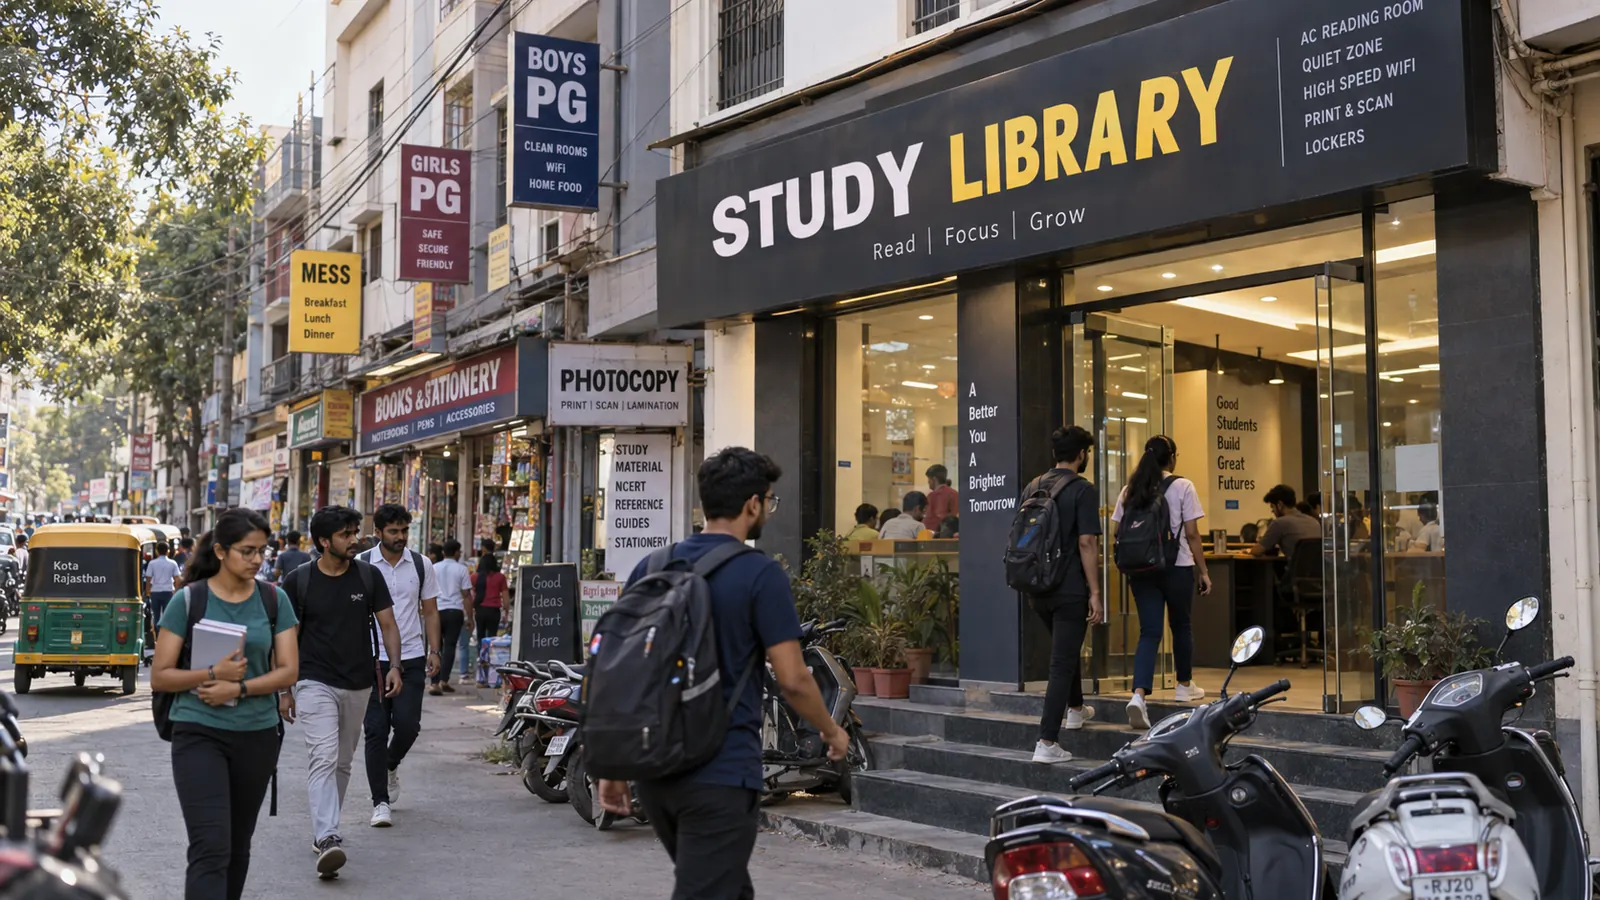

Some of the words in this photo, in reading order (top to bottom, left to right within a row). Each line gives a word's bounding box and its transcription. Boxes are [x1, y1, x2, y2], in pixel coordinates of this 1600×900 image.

[1301, 28, 1317, 46] AC
[1322, 10, 1379, 39] READING
[1384, 0, 1423, 21] ROOM
[528, 46, 586, 76] BOYS
[1302, 49, 1341, 73] QUIET
[1346, 37, 1383, 61] ZONE
[1303, 79, 1335, 100] HIGH
[1339, 67, 1382, 91] SPEED
[1386, 57, 1416, 78] WIFI
[526, 75, 587, 124] PG
[1304, 105, 1341, 128] PRINT
[1345, 103, 1354, 118] &
[1357, 92, 1393, 115] SCAN
[524, 140, 553, 154] CLEAN
[556, 144, 588, 157] ROOMS
[1305, 129, 1365, 155] LOCKERS
[411, 154, 460, 175] GIRLS
[712, 141, 923, 258] STUDY
[949, 56, 1234, 204] LIBRARY
[546, 161, 566, 173] WiFi
[529, 178, 555, 191] HOME
[558, 181, 582, 193] FOOD
[410, 176, 461, 214] PG
[422, 229, 442, 239] SAFE
[873, 233, 916, 260] Read
[945, 222, 999, 247] Focus
[1030, 204, 1087, 232] Grow
[418, 244, 449, 255] SECURE
[416, 259, 454, 270] FRIENDLY
[302, 262, 351, 285] MESS
[304, 297, 347, 308] Breakfast
[304, 313, 331, 324] Lunch
[304, 329, 335, 339] Dinner
[560, 369, 679, 392] PHOTOCOPY
[969, 382, 977, 397] A
[375, 386, 413, 423] BOOKS
[415, 389, 424, 411] &
[561, 400, 587, 410] PRINT
[595, 400, 619, 410] SCAN
[627, 401, 679, 410] LAMINATION
[1216, 395, 1239, 410] Good
[446, 401, 495, 424] ACCESSORIES
[969, 405, 998, 421] Better
[1217, 415, 1258, 432] Students
[969, 429, 987, 443] You
[1217, 435, 1240, 451] Build
[615, 444, 648, 456] STUDY
[615, 461, 663, 473] MATERIAL
[969, 452, 977, 467] A
[1217, 455, 1245, 470] Great
[615, 481, 646, 492] NCERT
[969, 473, 1006, 492] Brighter
[1218, 475, 1255, 490] Futures
[615, 499, 664, 510] REFERENCE
[969, 497, 1016, 513] Tomorrow
[615, 517, 650, 529] GUIDES
[615, 536, 668, 549] STATIONERY
[53, 560, 79, 571] Kota
[53, 573, 107, 585] Rajasthan
[531, 574, 562, 590] Good
[531, 594, 563, 609] Ideas
[531, 613, 562, 628] Start
[532, 633, 559, 648] Here
[1431, 877, 1474, 895] RJ20
